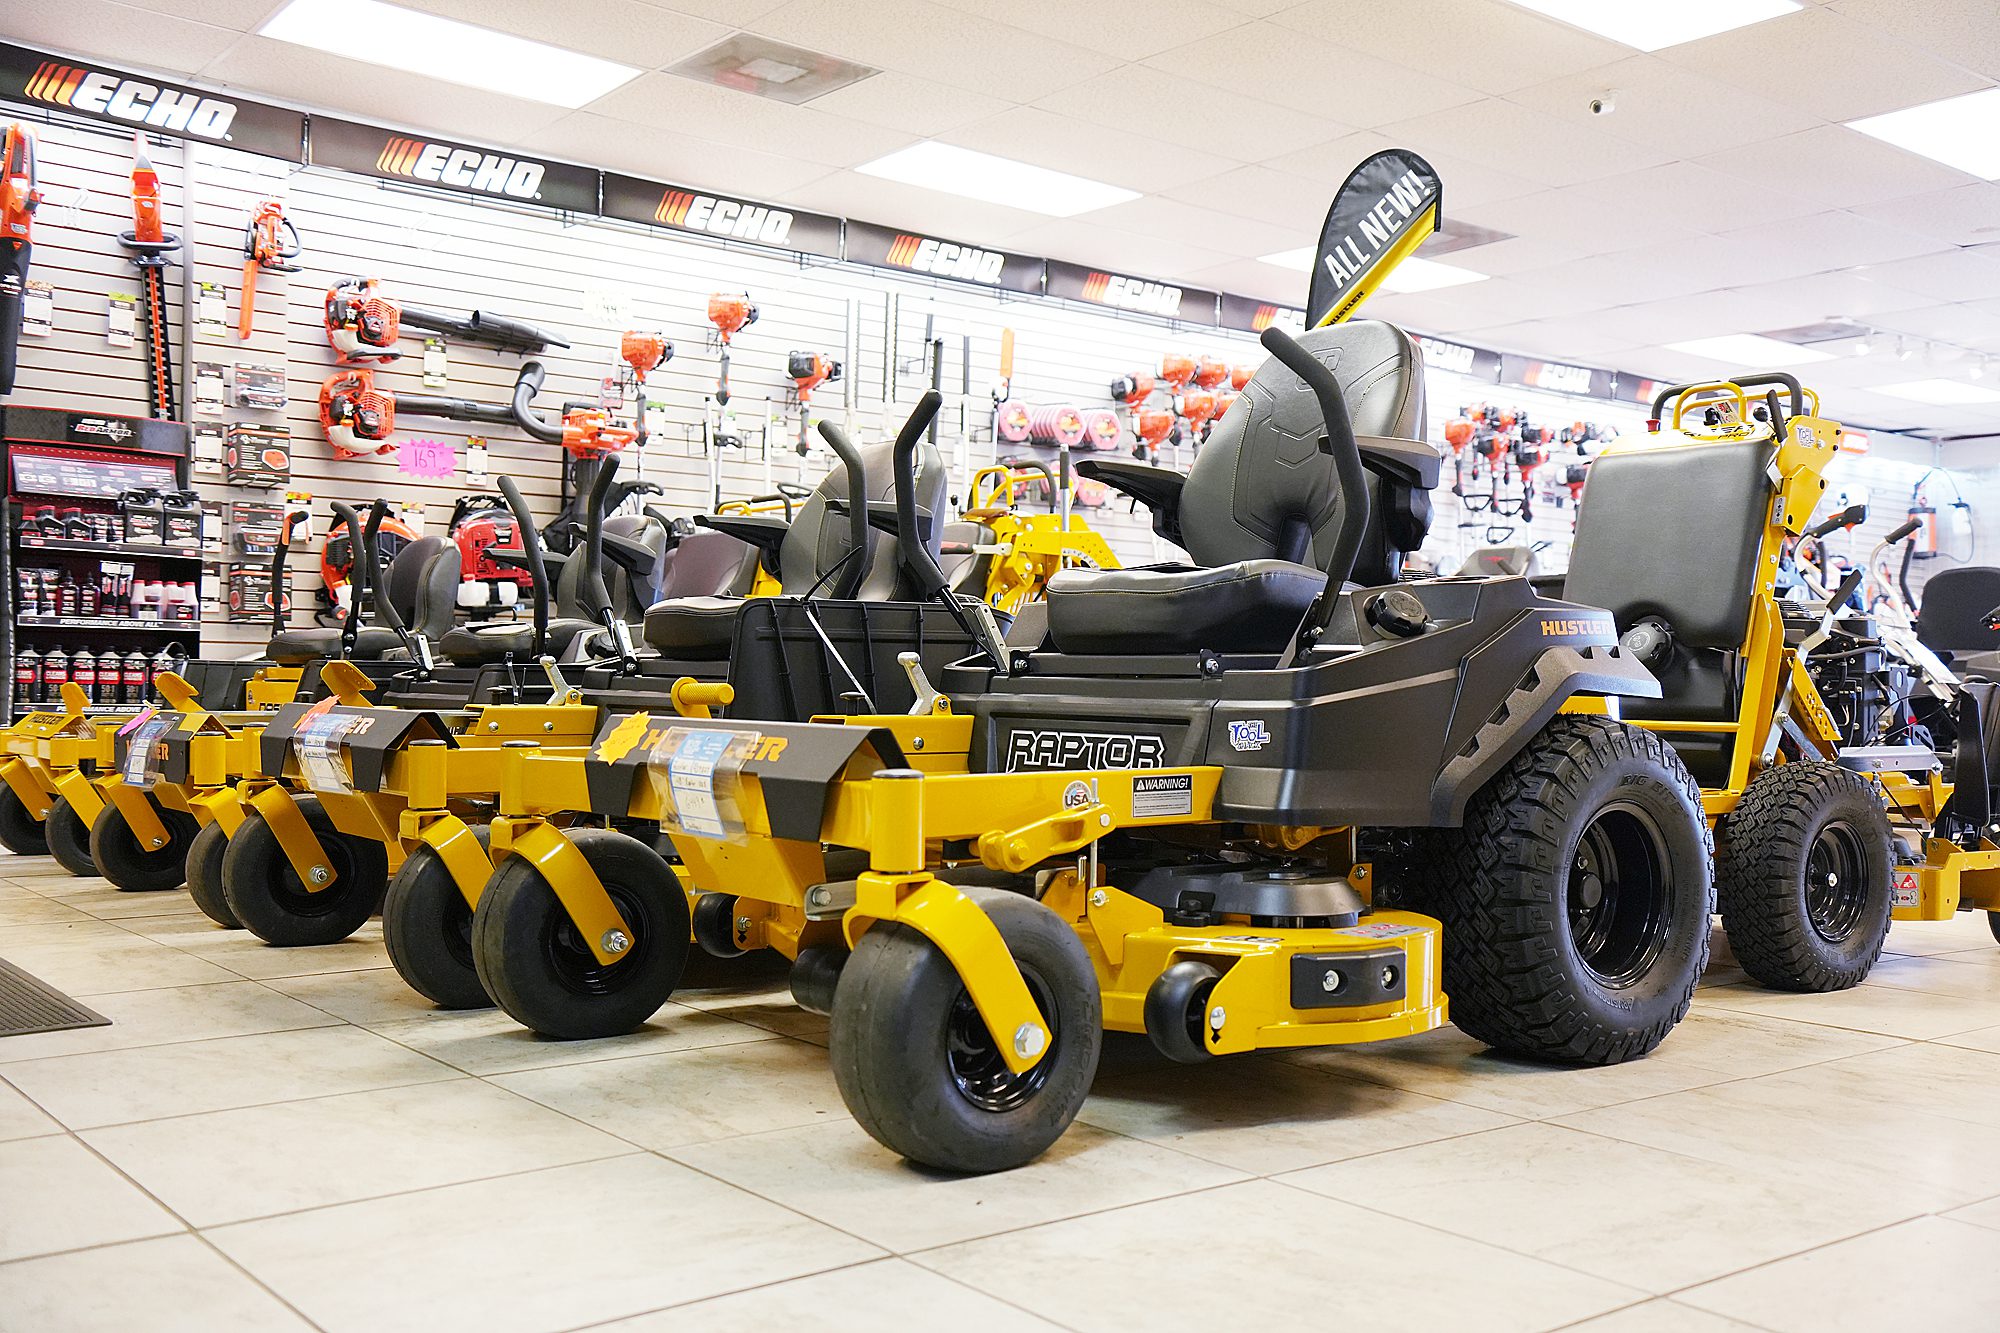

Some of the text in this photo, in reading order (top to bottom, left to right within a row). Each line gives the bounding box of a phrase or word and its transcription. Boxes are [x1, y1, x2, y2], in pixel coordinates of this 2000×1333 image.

[70, 72, 238, 140] ECHO
[411, 143, 546, 199] ECHO
[683, 195, 795, 245] ECHO
[1324, 169, 1432, 289] ALL NEW!
[414, 449, 437, 469] 169
[60, 618, 118, 628] PERFORMANCE
[118, 620, 145, 628] ABOVE
[1541, 620, 1614, 636] HUSTLER
[1230, 723, 1268, 744] TOOL
[1005, 729, 1166, 773] RAPTOR
[1145, 777, 1189, 790] WARNING!
[1065, 794, 1089, 807] USA
